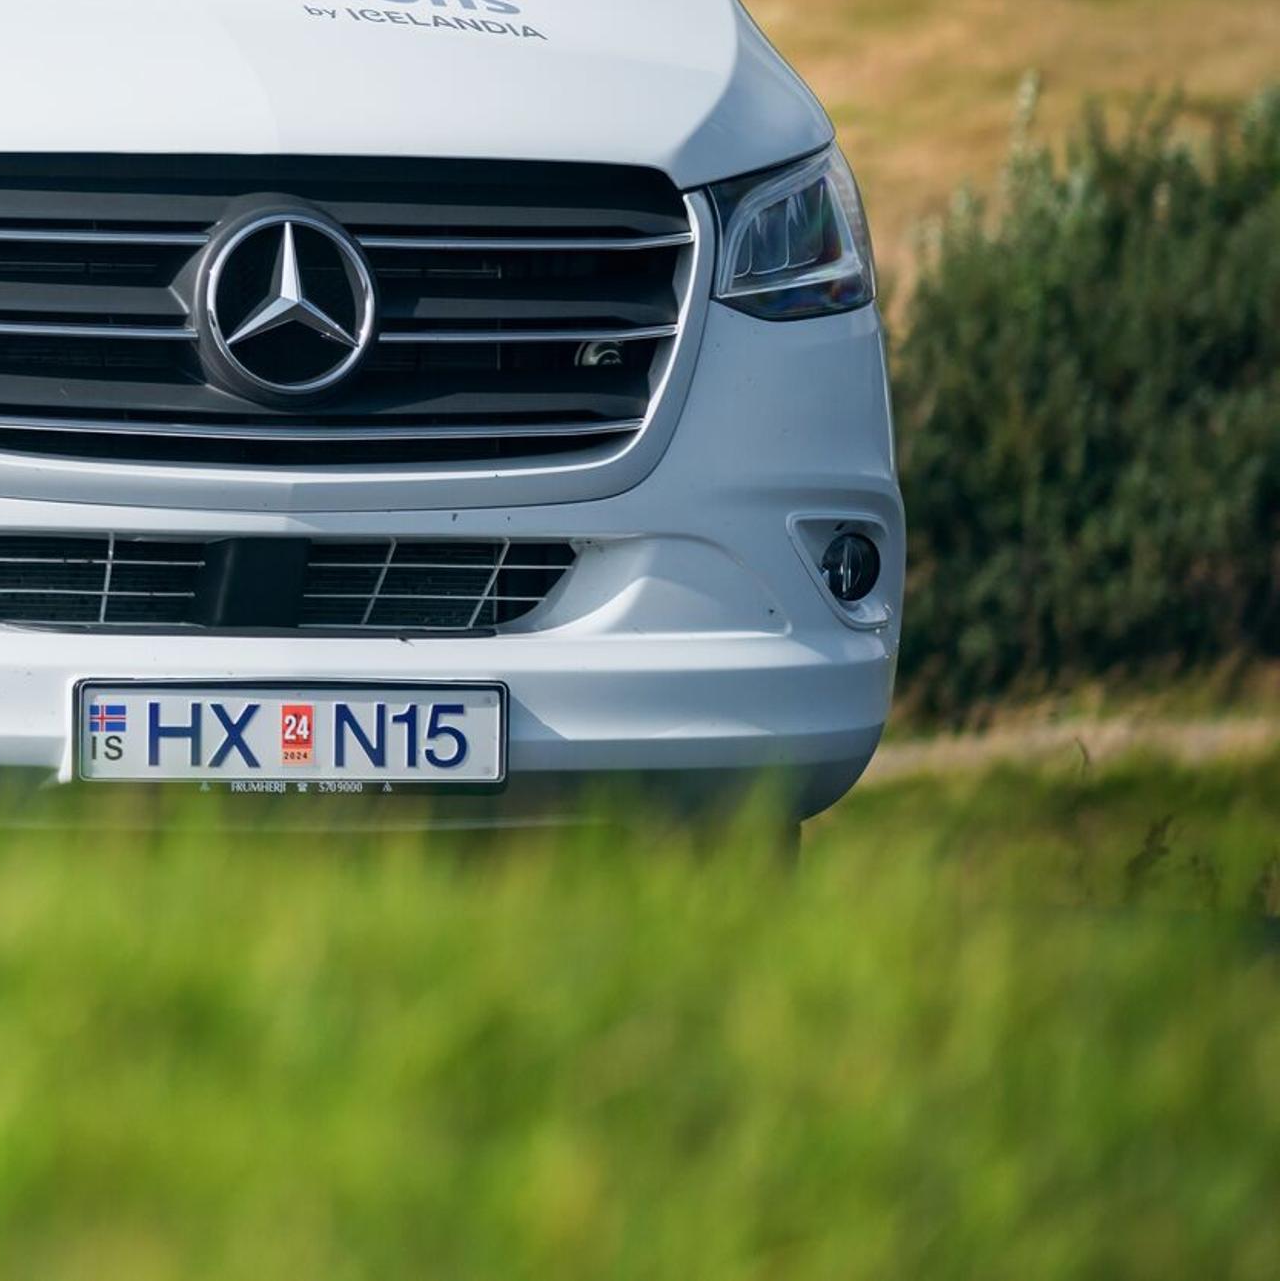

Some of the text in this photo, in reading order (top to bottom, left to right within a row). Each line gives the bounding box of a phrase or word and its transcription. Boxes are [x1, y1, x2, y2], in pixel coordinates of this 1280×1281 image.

[303, 5, 549, 40] by ICELANDIA
[148, 702, 468, 769] HX N15
[283, 714, 310, 741] 24
[91, 735, 123, 761] IS
[283, 751, 308, 761] 2024
